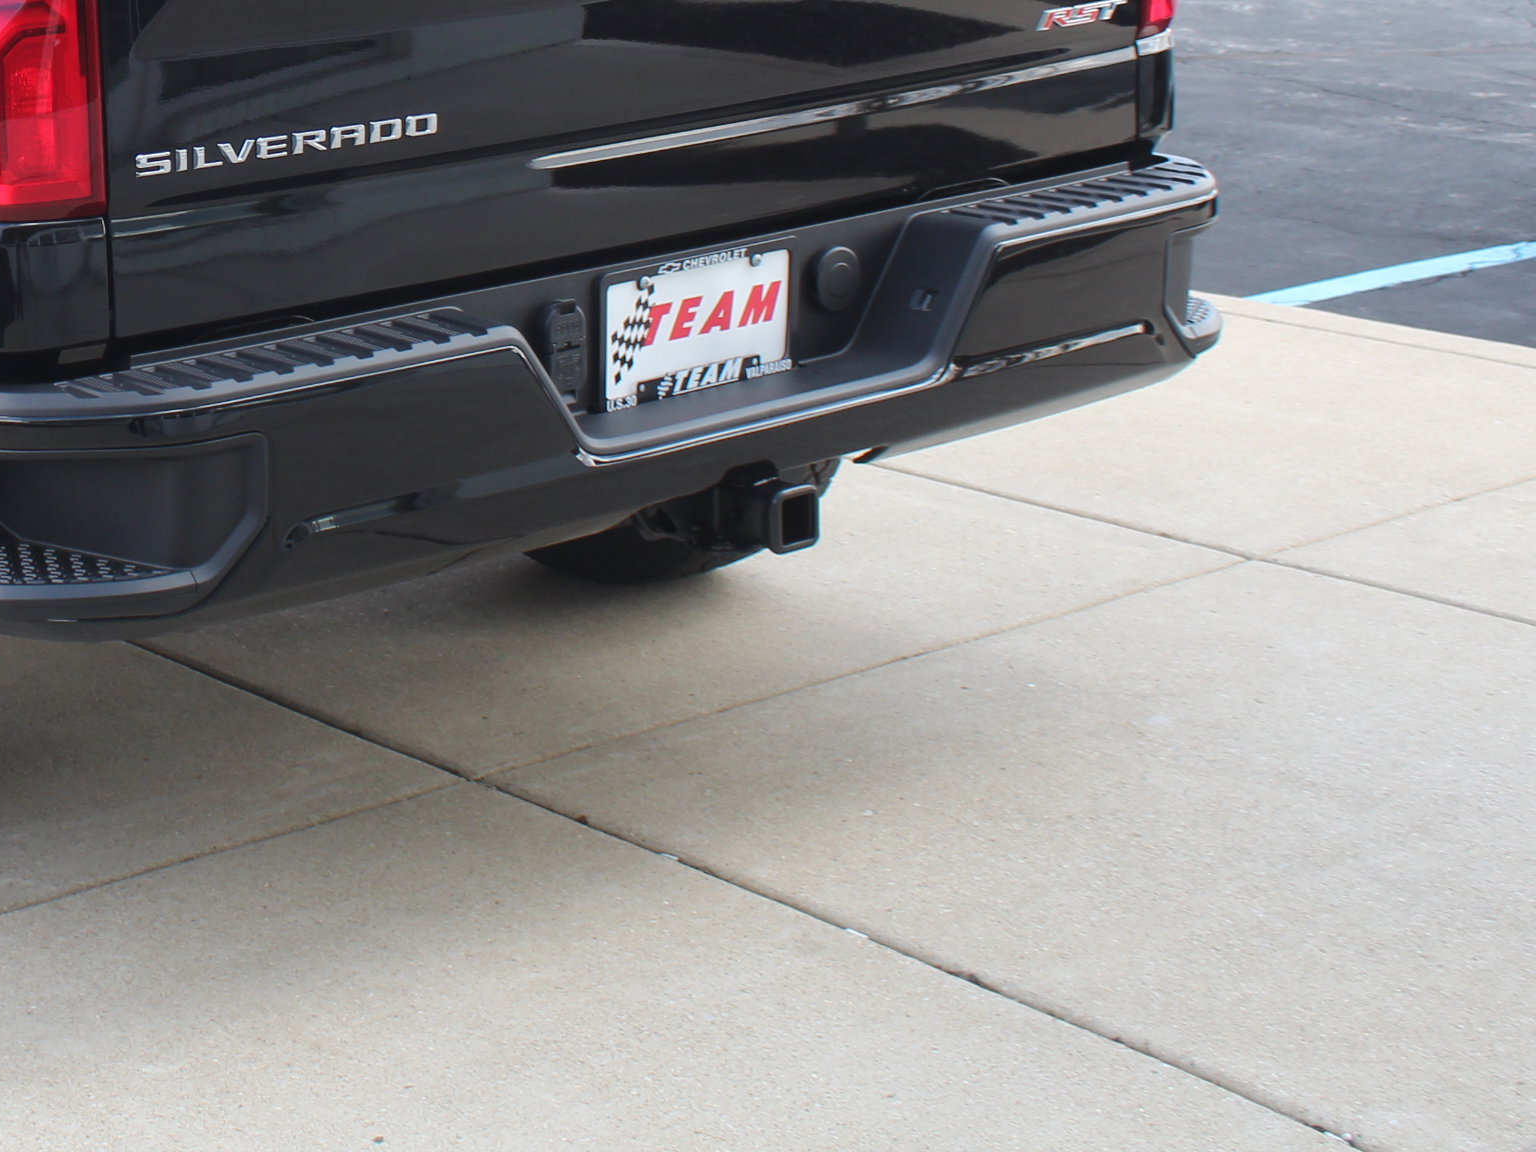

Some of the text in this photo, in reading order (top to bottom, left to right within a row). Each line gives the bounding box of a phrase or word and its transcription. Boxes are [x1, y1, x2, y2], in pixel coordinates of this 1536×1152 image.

[135, 112, 438, 177] SILVERADO
[682, 248, 748, 272] CHEVROLET
[641, 280, 782, 347] TEAM
[671, 357, 743, 394] TEAM
[746, 358, 792, 380] VALPARAISO
